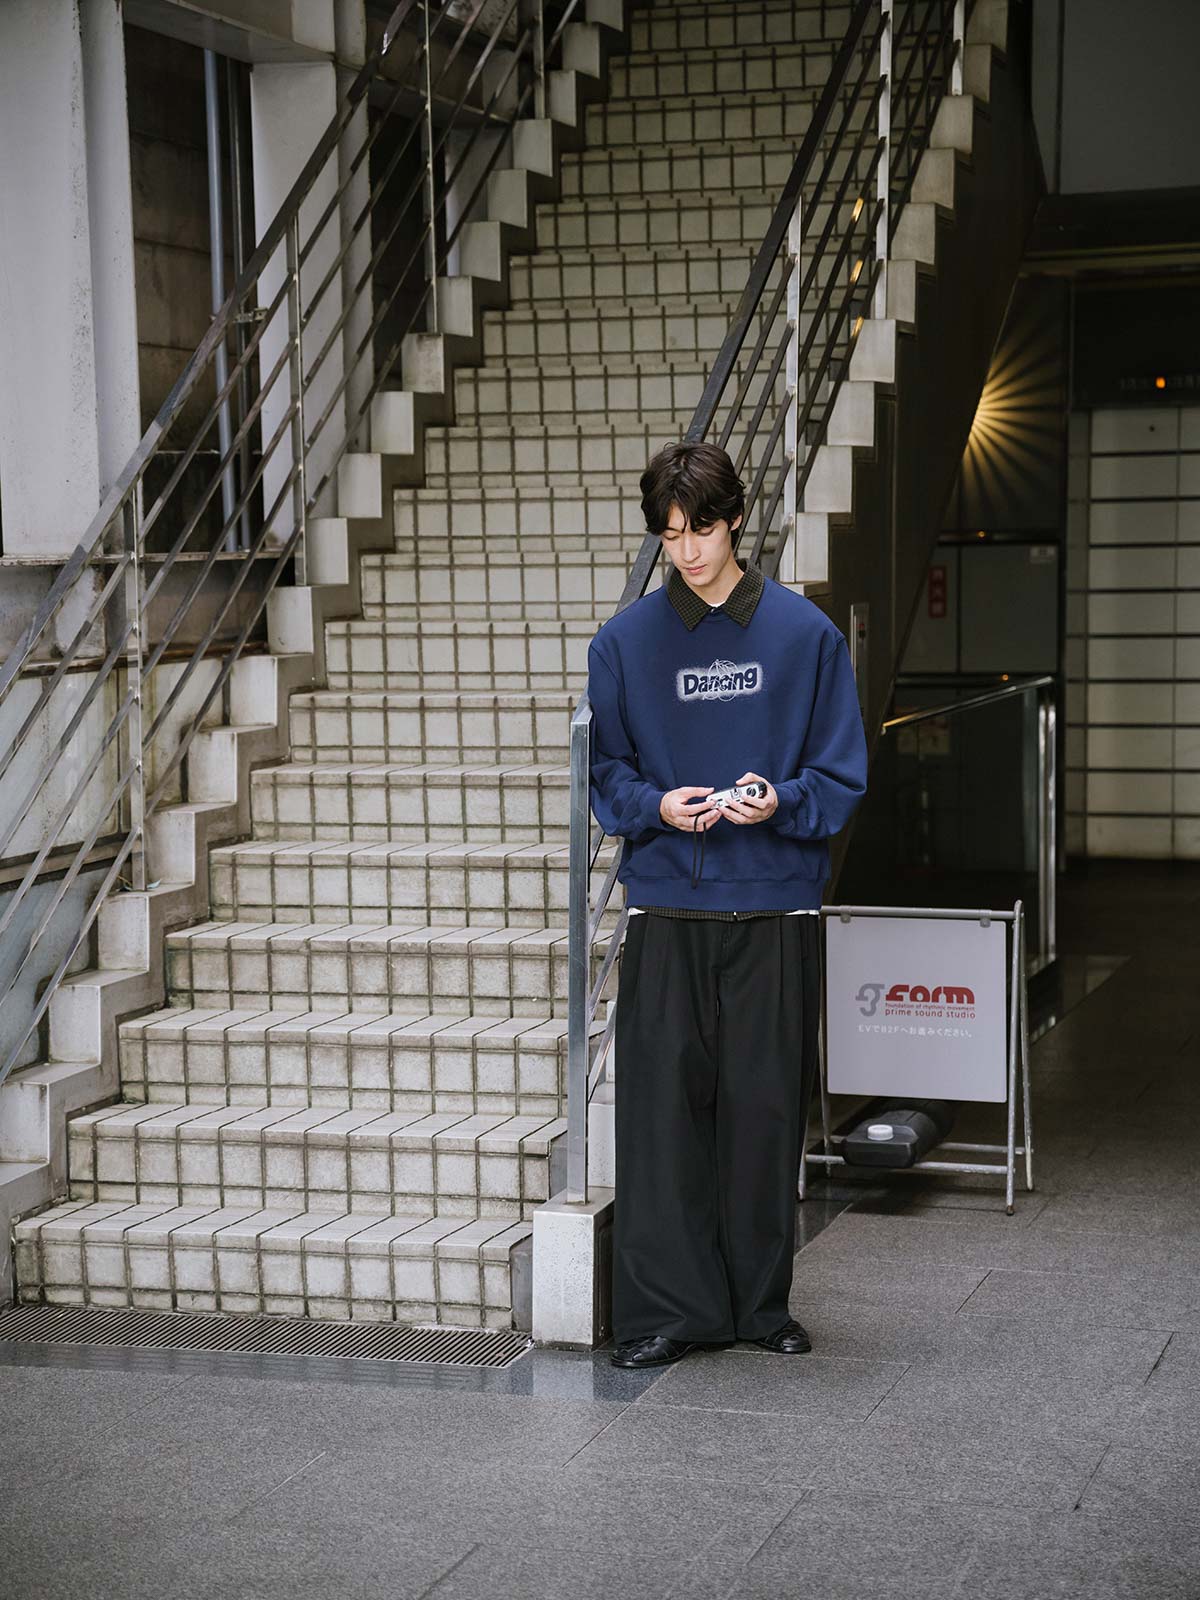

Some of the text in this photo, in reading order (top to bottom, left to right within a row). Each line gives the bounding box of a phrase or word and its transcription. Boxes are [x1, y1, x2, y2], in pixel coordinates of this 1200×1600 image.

[683, 667, 758, 695] Dancing
[885, 1008, 976, 1019] prime sound studio
